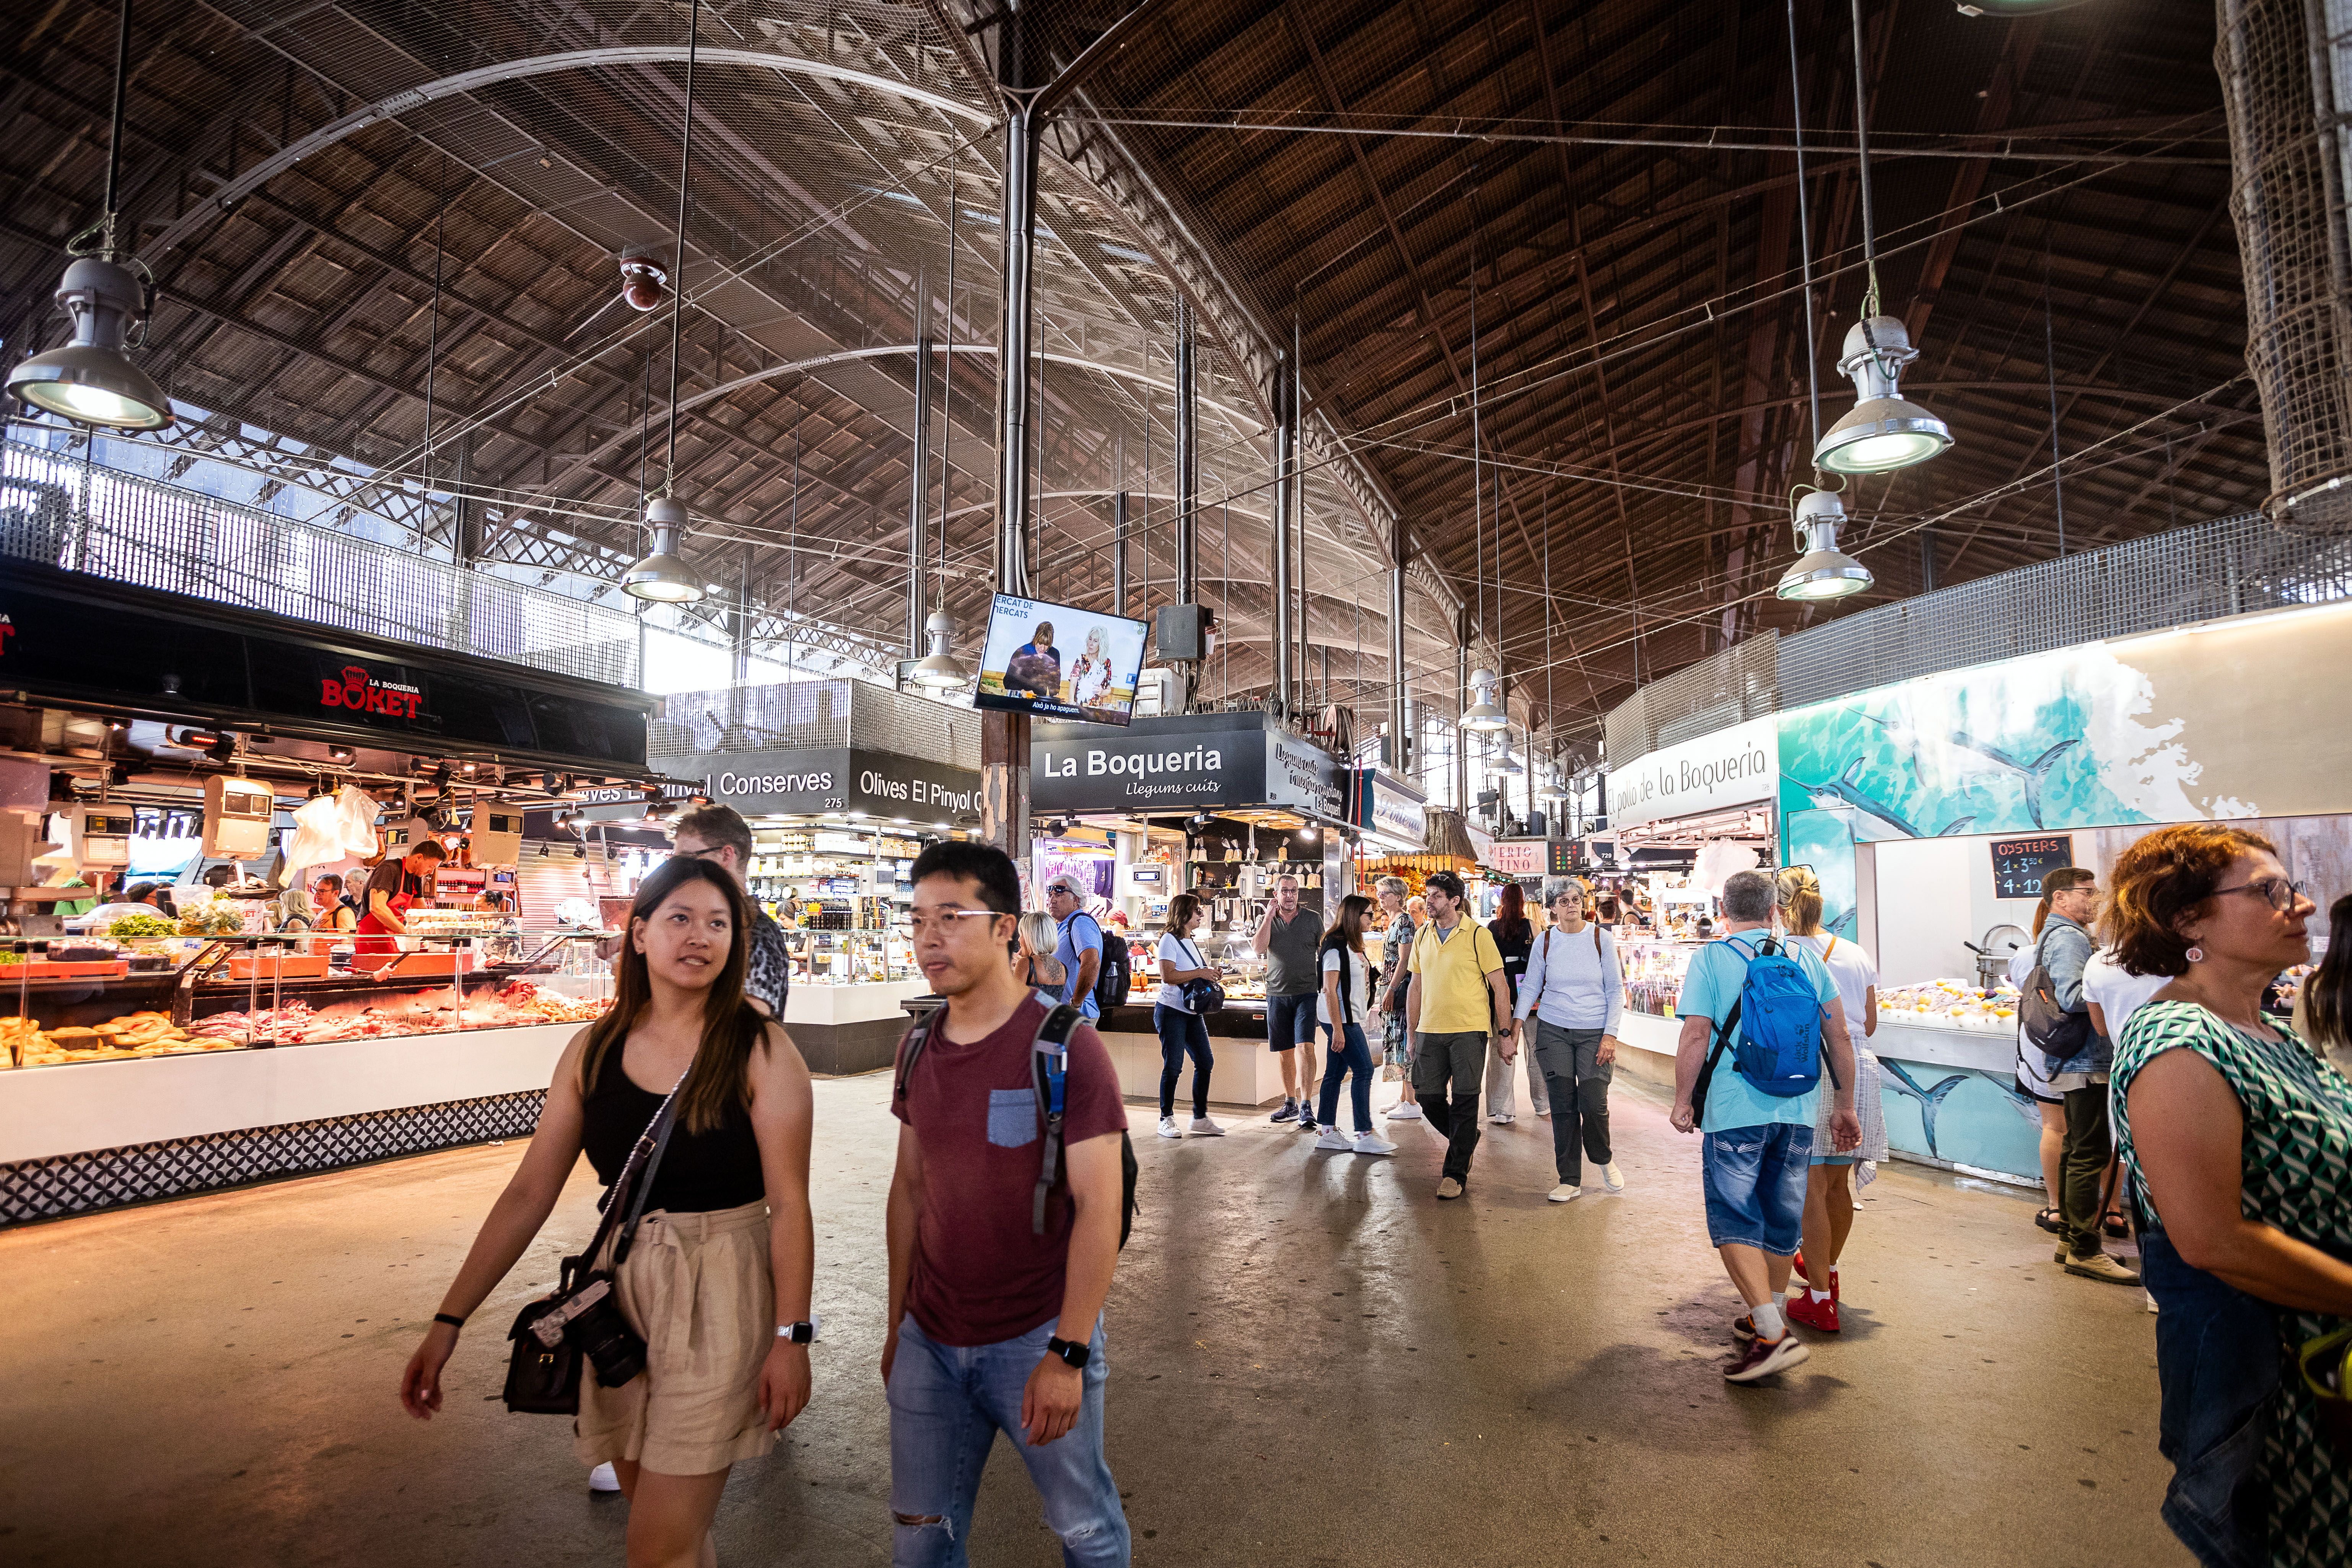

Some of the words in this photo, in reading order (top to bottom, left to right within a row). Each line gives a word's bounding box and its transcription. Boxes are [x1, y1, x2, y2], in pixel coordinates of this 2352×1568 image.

[1023, 601, 1034, 609] DE
[383, 681, 419, 694] BOQUERIA
[321, 679, 422, 719] BOKET
[1045, 753, 1078, 777] La
[1087, 744, 1222, 780] Boqueria
[720, 772, 832, 795] Conserves
[1126, 782, 1184, 798] Llegums
[1186, 778, 1222, 792] cuits
[1608, 788, 1616, 815] El
[1618, 780, 1637, 819] pollo
[1640, 772, 1653, 802] de
[1660, 767, 1673, 796] la
[1681, 741, 1766, 794] Boqueria
[861, 770, 907, 800] Olives
[912, 780, 926, 803] El
[931, 783, 970, 814] Pinyol
[825, 798, 842, 808] 275
[1998, 840, 2059, 855] OYSTERS
[1495, 860, 1530, 870] TINO
[2002, 860, 2013, 874] 1
[2004, 879, 2014, 894] 4
[1793, 1040, 1802, 1063] Jack
[1801, 1023, 1810, 1063] Wolfskin
